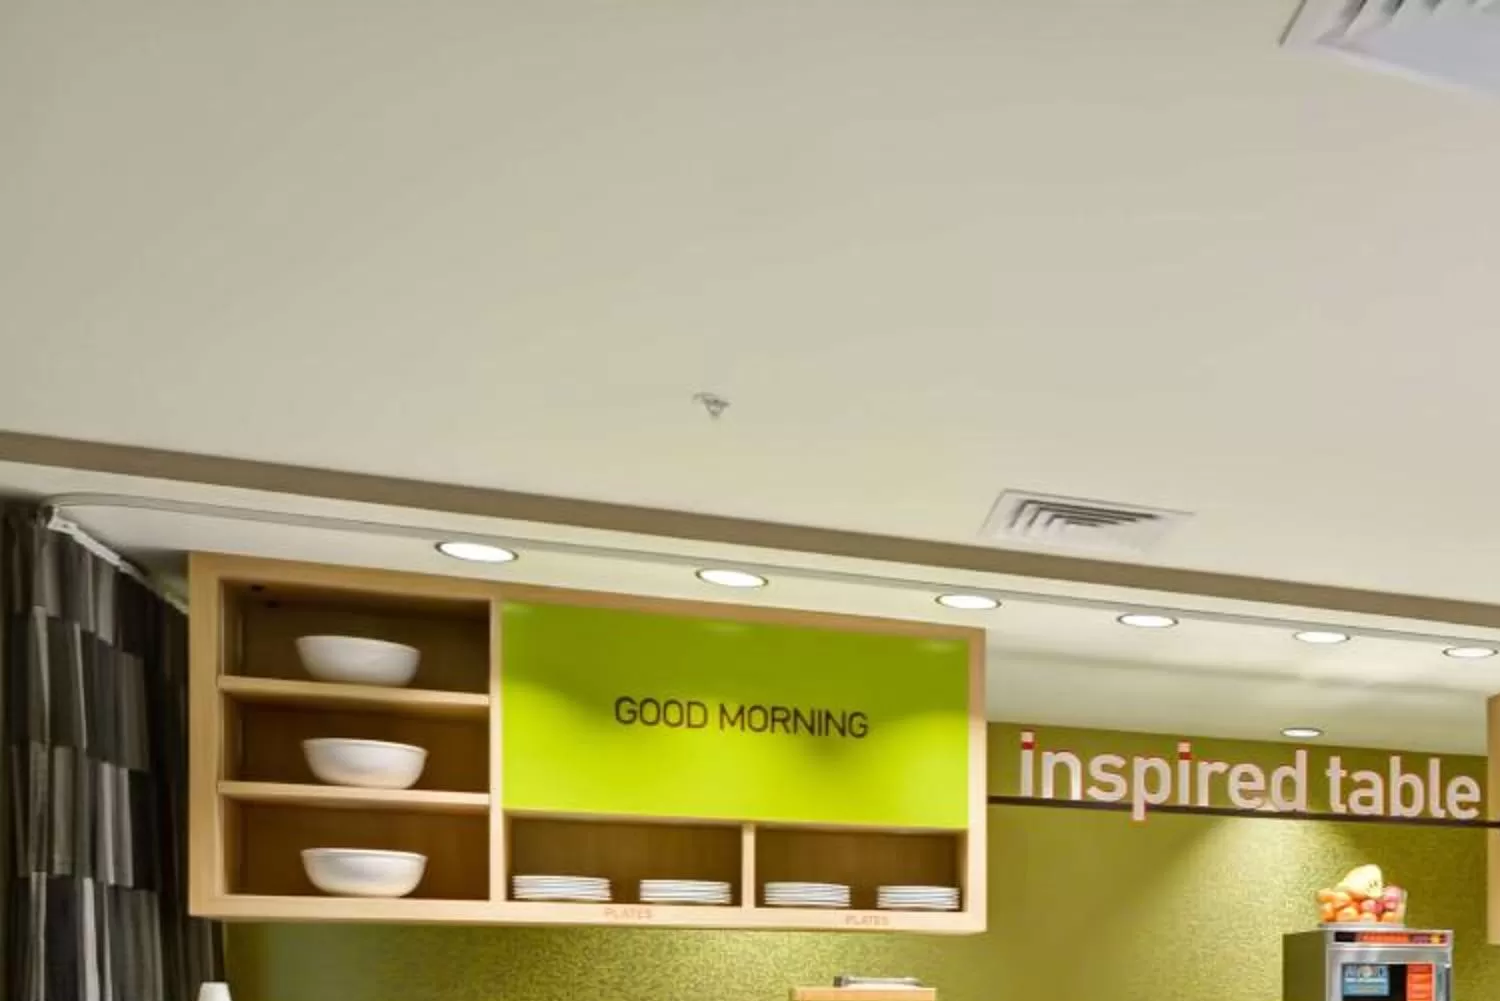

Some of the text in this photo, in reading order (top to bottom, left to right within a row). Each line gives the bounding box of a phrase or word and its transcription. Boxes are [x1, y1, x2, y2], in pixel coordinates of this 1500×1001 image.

[615, 696, 868, 739] GOOD MORNING
[1020, 730, 1481, 822] inspired table
